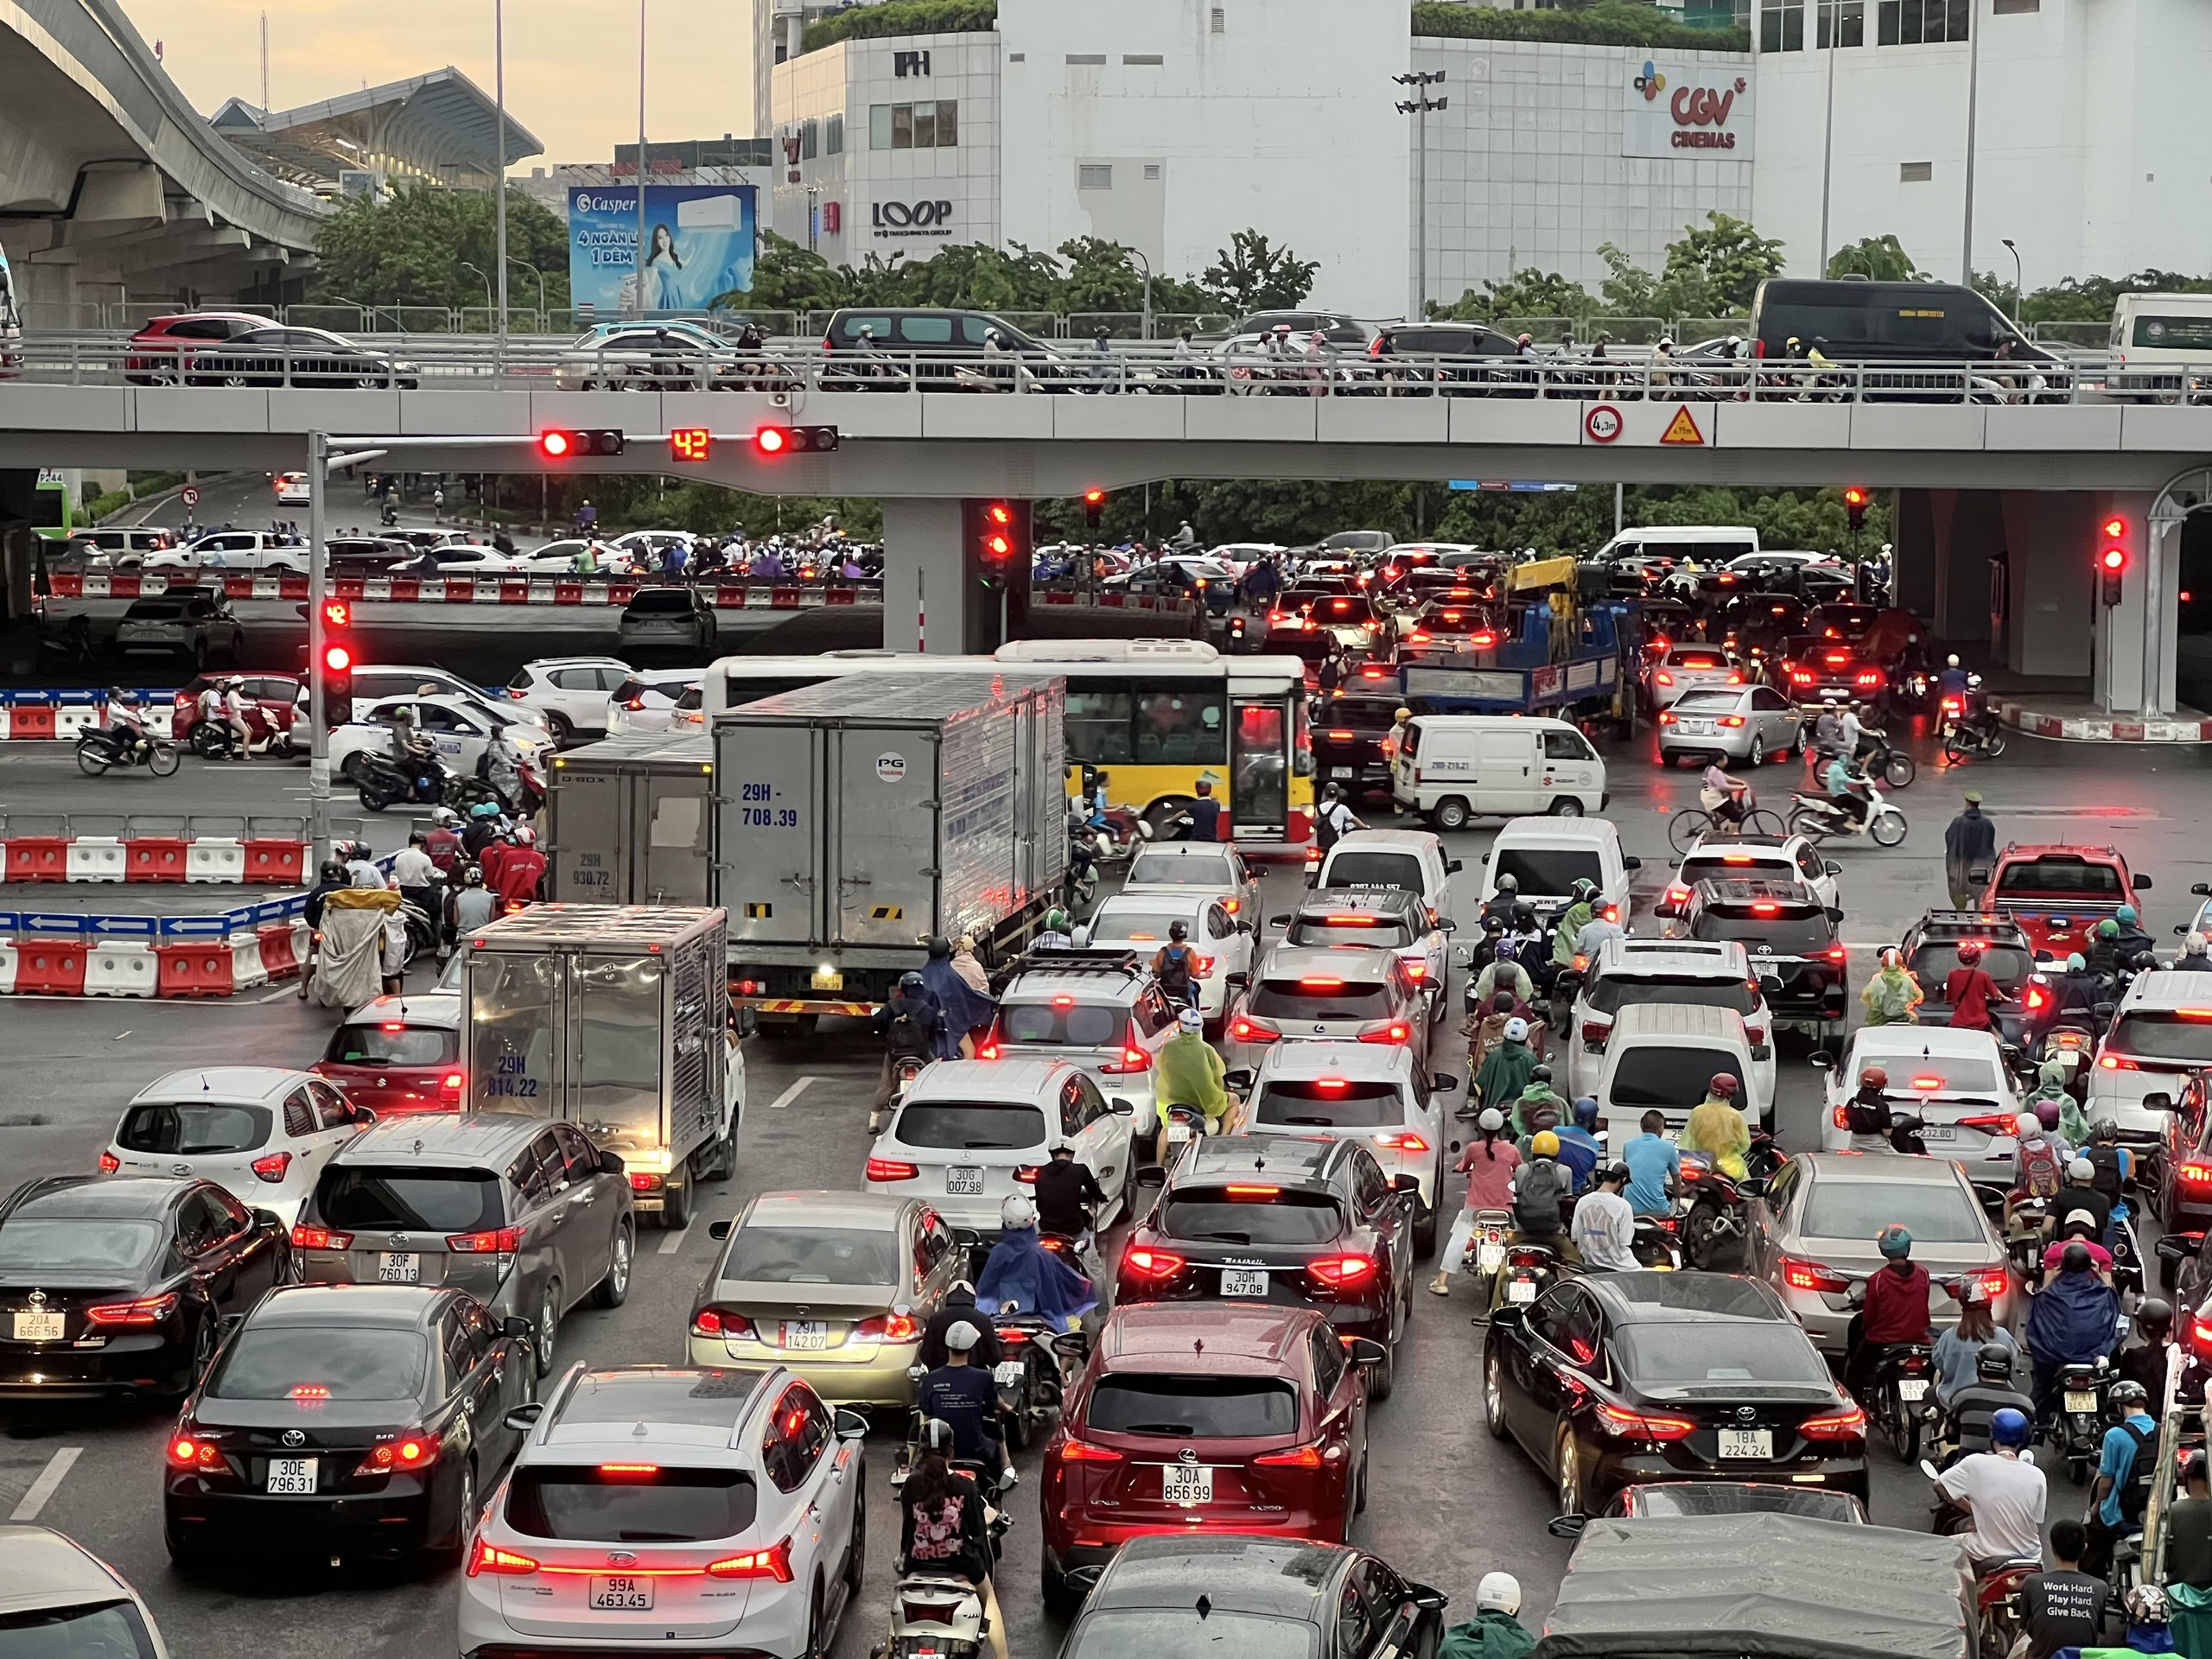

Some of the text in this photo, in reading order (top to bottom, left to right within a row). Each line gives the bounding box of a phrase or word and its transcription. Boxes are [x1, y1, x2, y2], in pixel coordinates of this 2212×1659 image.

[1671, 86, 1734, 125] CGV
[1671, 131, 1735, 149] CINEMAS
[592, 195, 636, 214] Casper
[873, 200, 952, 226] LOOP
[578, 231, 589, 245] 4
[592, 230, 621, 245] NGÀN
[592, 245, 632, 263] 1 ĐÊM
[1592, 416, 1616, 431] 4,3m
[675, 431, 705, 457] 42
[878, 759, 904, 768] PG
[743, 784, 771, 801] 29H
[742, 808, 798, 827] 708.39
[581, 853, 601, 868] 29H
[573, 870, 609, 886] 930.72
[1758, 963, 1771, 972] 30E
[498, 1056, 525, 1074] 29H
[488, 1077, 537, 1097] 814.22
[957, 1169, 975, 1180] 30G
[948, 1181, 982, 1192] 007.98
[390, 1255, 410, 1268] 30F
[380, 1268, 416, 1281] 760.13
[1235, 1272, 1255, 1283] 30H
[1226, 1283, 1262, 1294] 947.08
[29, 1314, 49, 1325] 20A
[796, 1321, 817, 1334] 29A
[788, 1336, 824, 1349] 142.07
[1735, 1432, 1757, 1444] 18A
[1725, 1446, 1766, 1457] 224.24
[281, 1460, 306, 1476] 30E
[1175, 1468, 1200, 1484] 30A
[270, 1476, 315, 1492] 796.31
[1165, 1484, 1210, 1500] 856.99
[608, 1579, 635, 1592] 99A
[2044, 1582, 2094, 1594] Work Hard.
[597, 1593, 646, 1607] 463.45
[2048, 1594, 2093, 1606] Play Hard.
[2047, 1607, 2069, 1618] Give
